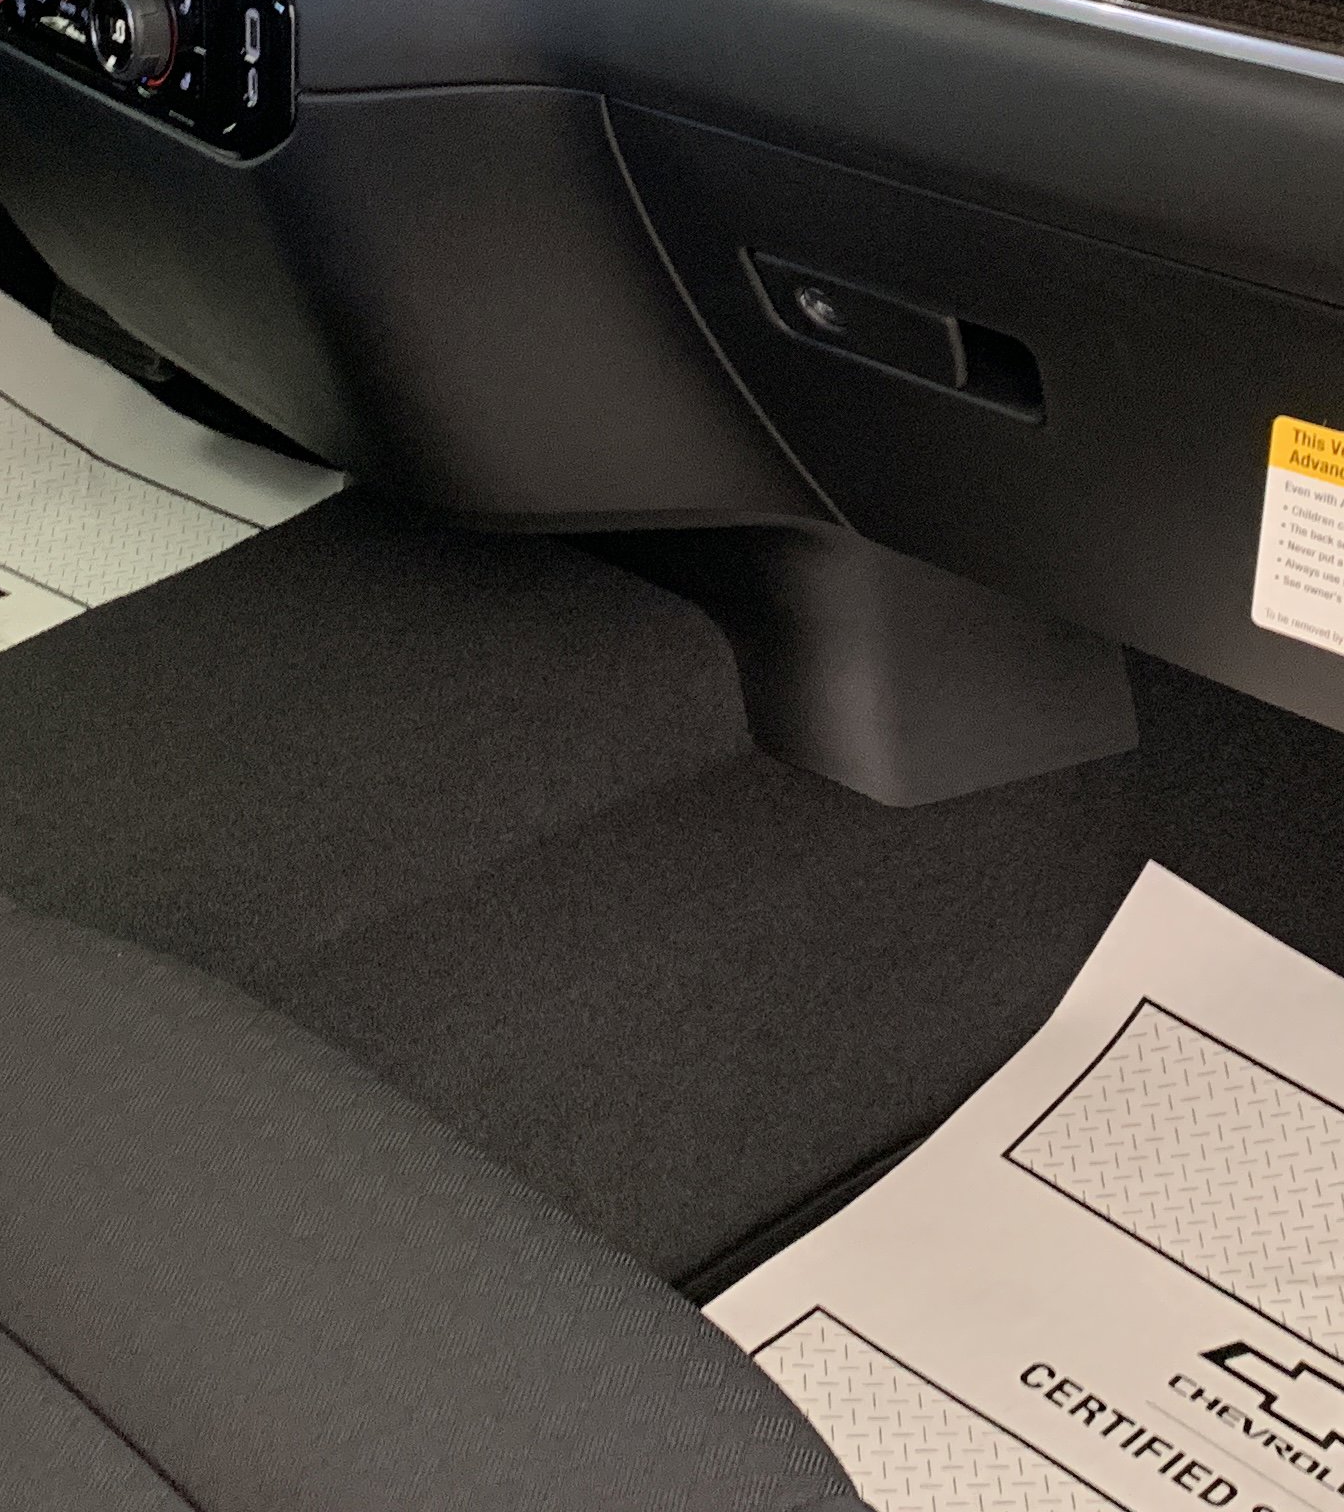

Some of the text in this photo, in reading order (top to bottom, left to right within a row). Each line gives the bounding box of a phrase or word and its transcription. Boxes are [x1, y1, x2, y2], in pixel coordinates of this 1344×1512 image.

[1293, 428, 1325, 452] This
[1285, 480, 1311, 496] Even
[1314, 490, 1337, 507] with
[1291, 505, 1335, 528] Children
[1290, 522, 1308, 537] The
[1310, 529, 1334, 546] back
[1287, 540, 1316, 558] Never
[1318, 551, 1335, 565] put
[1283, 575, 1301, 589] See
[1285, 558, 1320, 578] Always
[1323, 573, 1340, 585] use
[1264, 607, 1275, 620] To
[1278, 612, 1289, 625] be
[1291, 618, 1331, 639] removed
[1333, 631, 1344, 646] by
[1019, 1361, 1239, 1507] CERTIFIED
